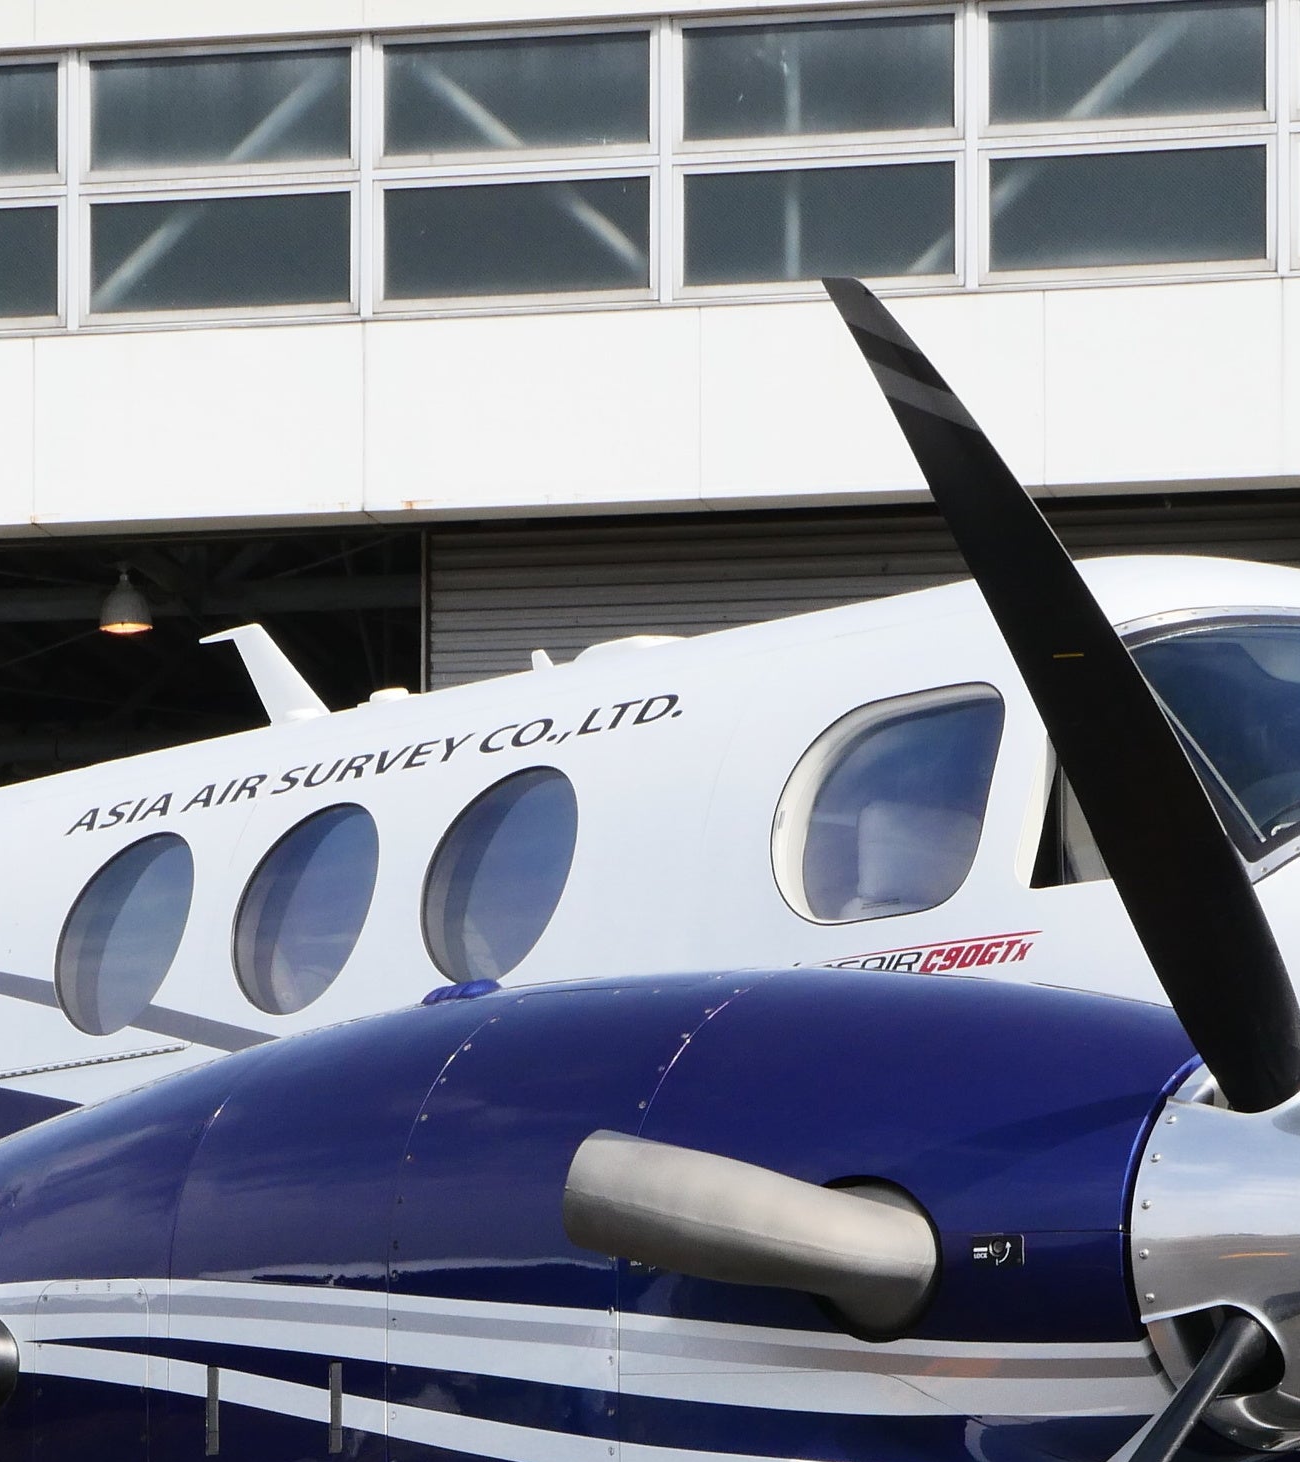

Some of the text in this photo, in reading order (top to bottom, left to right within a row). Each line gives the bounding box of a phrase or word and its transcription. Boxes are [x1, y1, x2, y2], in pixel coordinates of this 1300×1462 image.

[65, 792, 173, 836] ASIA
[180, 774, 267, 813] AIR
[271, 733, 476, 795] SURVEY
